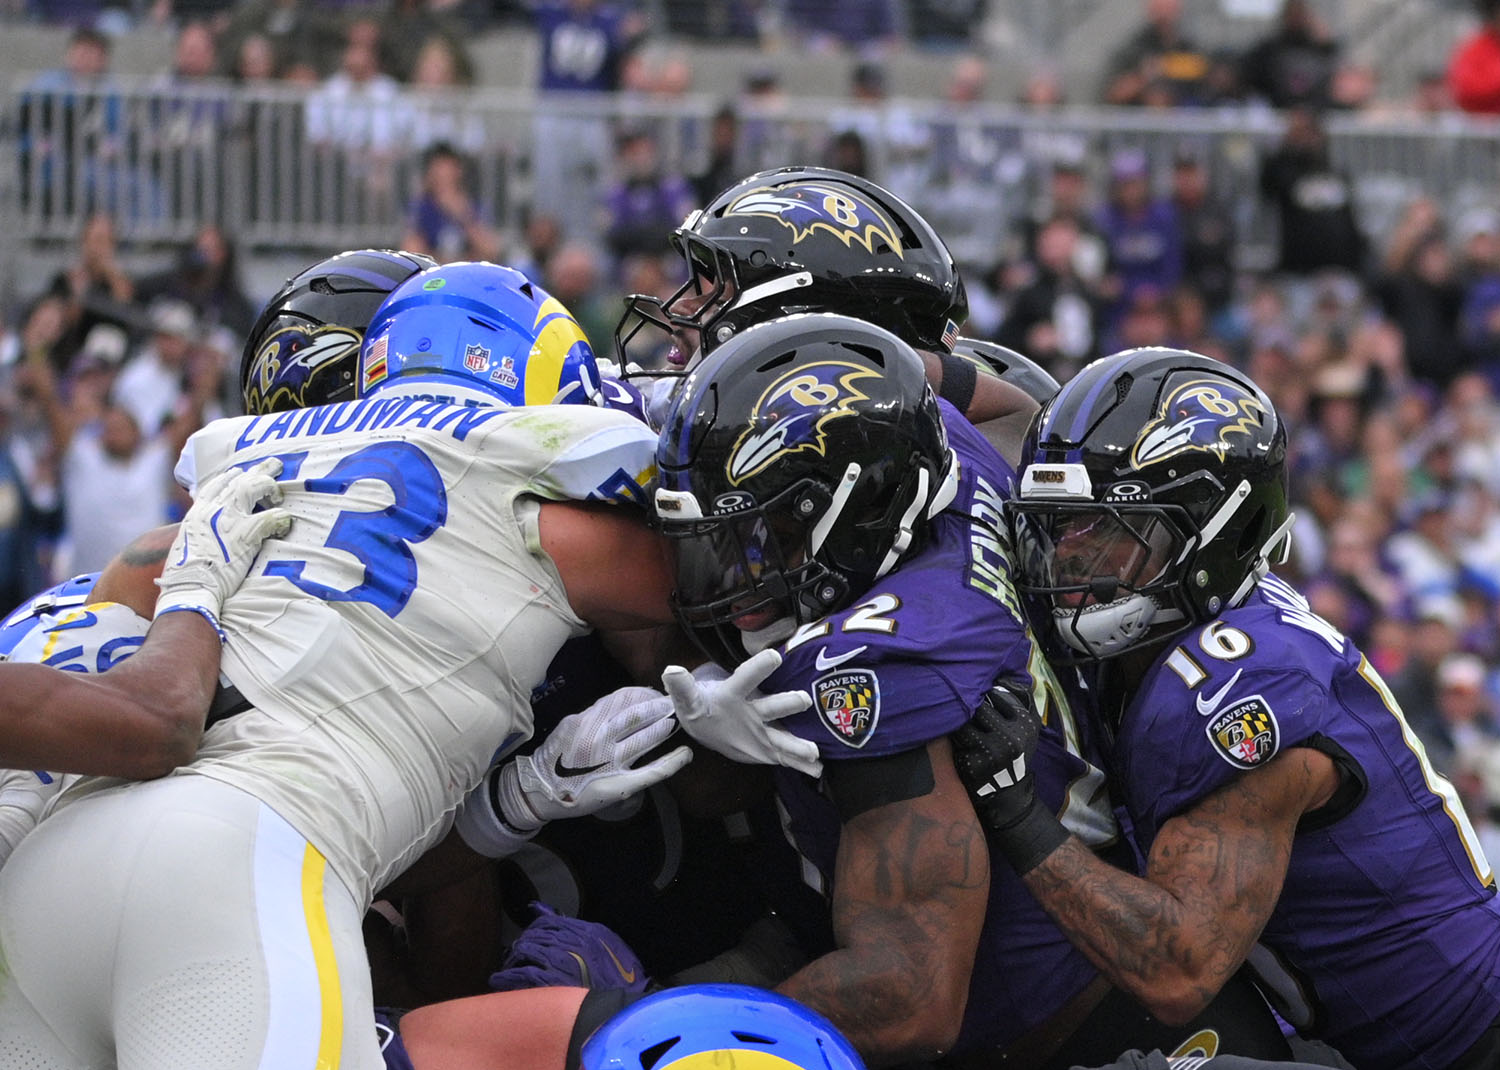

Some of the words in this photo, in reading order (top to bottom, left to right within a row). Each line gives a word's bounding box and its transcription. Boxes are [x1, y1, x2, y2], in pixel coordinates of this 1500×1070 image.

[466, 353, 486, 371] NFL
[492, 370, 518, 386] CATCH
[235, 400, 503, 452] LANDMAN
[1106, 493, 1149, 502] OAKLEY
[713, 501, 752, 516] OAKLEY
[785, 592, 901, 655] 22
[1163, 620, 1252, 690] 16
[818, 675, 869, 692] RAVENS
[1212, 701, 1259, 733] RAVENS
